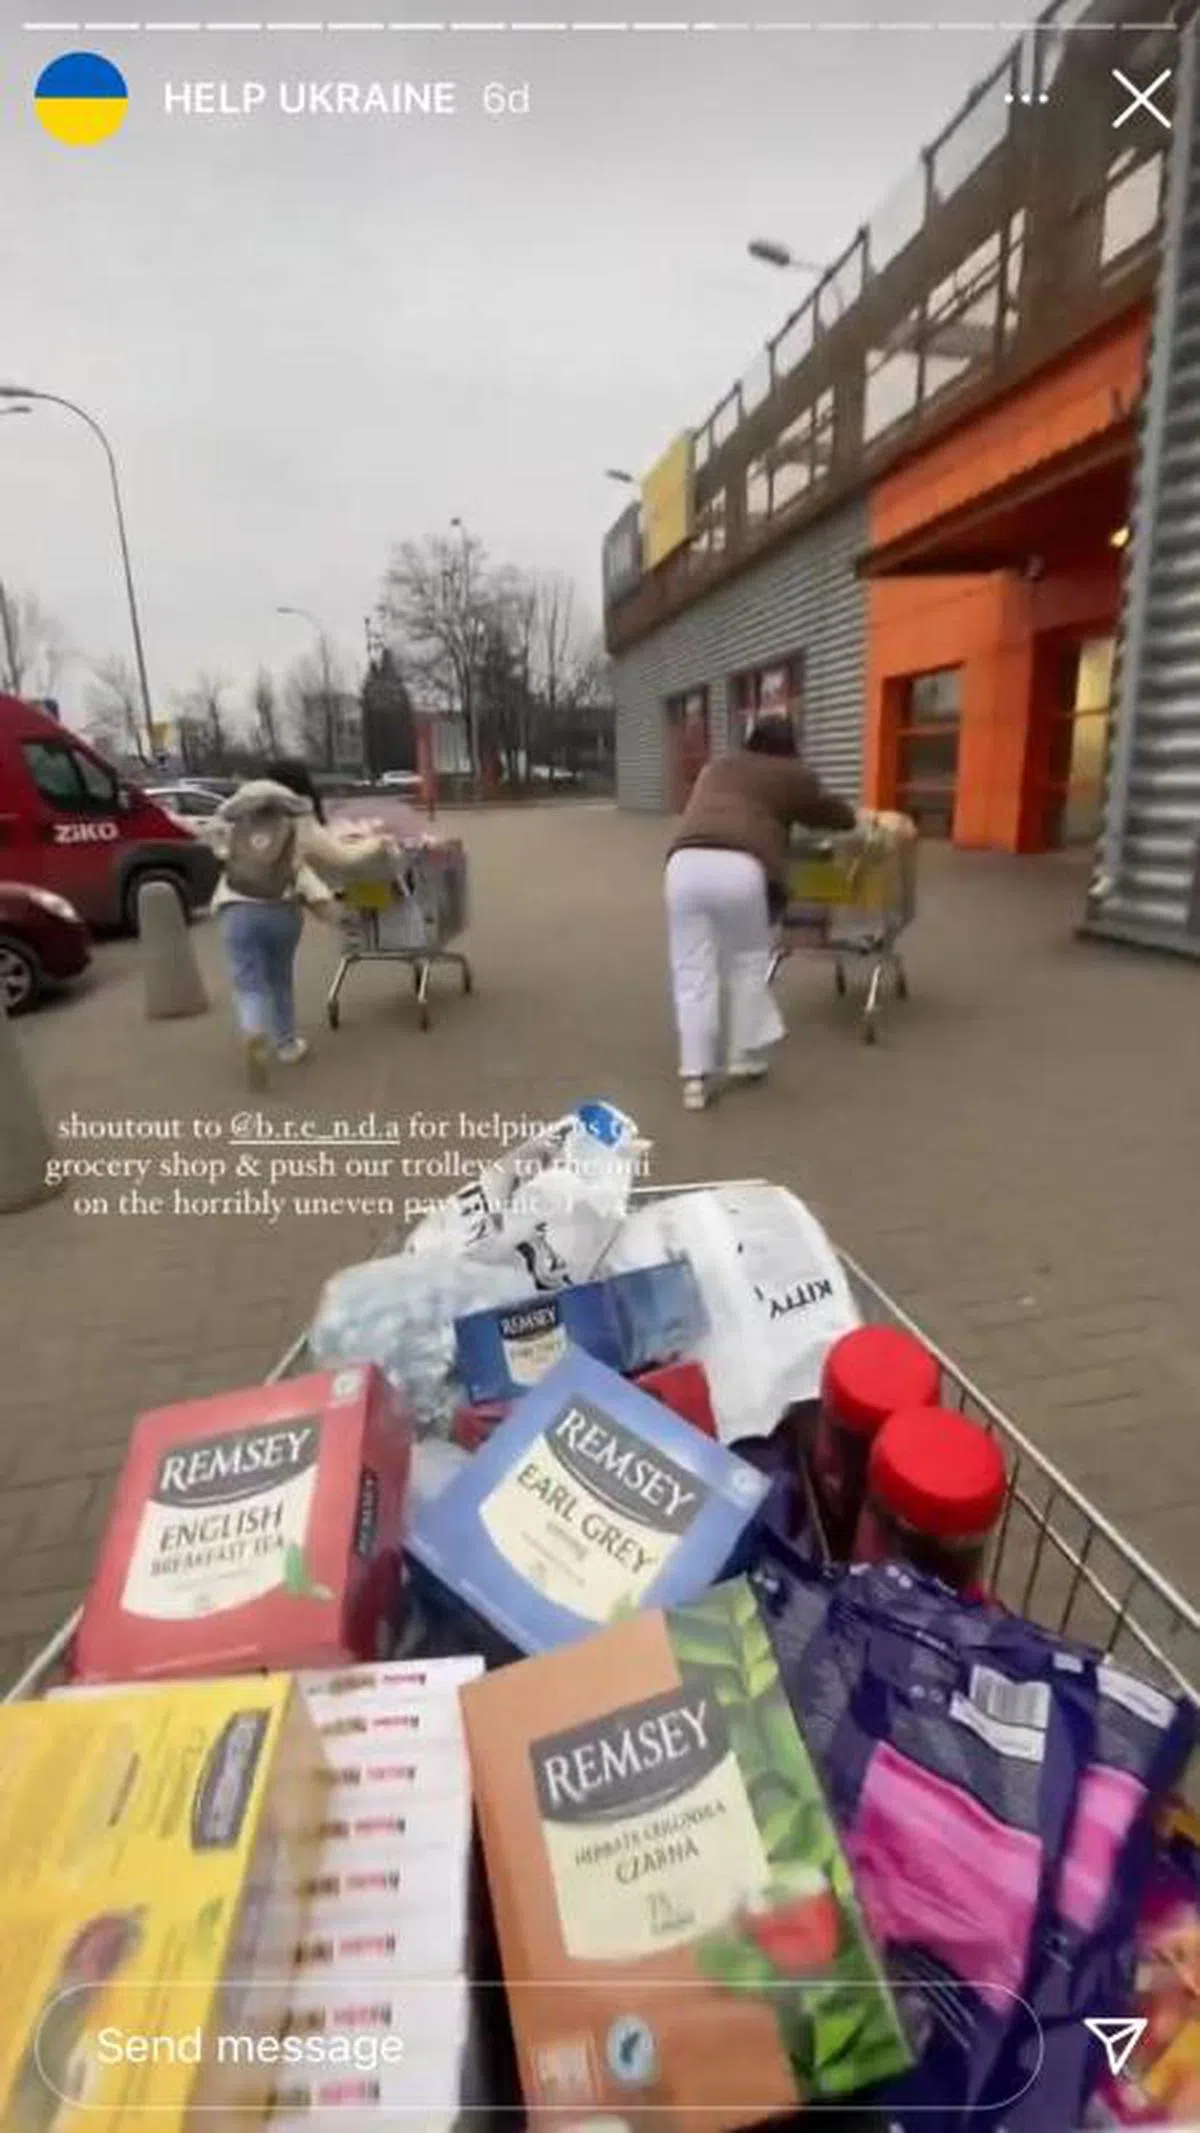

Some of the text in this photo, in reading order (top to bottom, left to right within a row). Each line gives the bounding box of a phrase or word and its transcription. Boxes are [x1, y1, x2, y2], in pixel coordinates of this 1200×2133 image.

[770, 1279, 832, 1319] KITTY
[160, 1427, 311, 1492] REMSEY
[556, 1407, 696, 1516] REMSEY
[160, 1499, 284, 1552] ENGLISH
[517, 1462, 575, 1523] EARL
[580, 1511, 653, 1574] GREY
[543, 1700, 709, 1806] REMSEY
